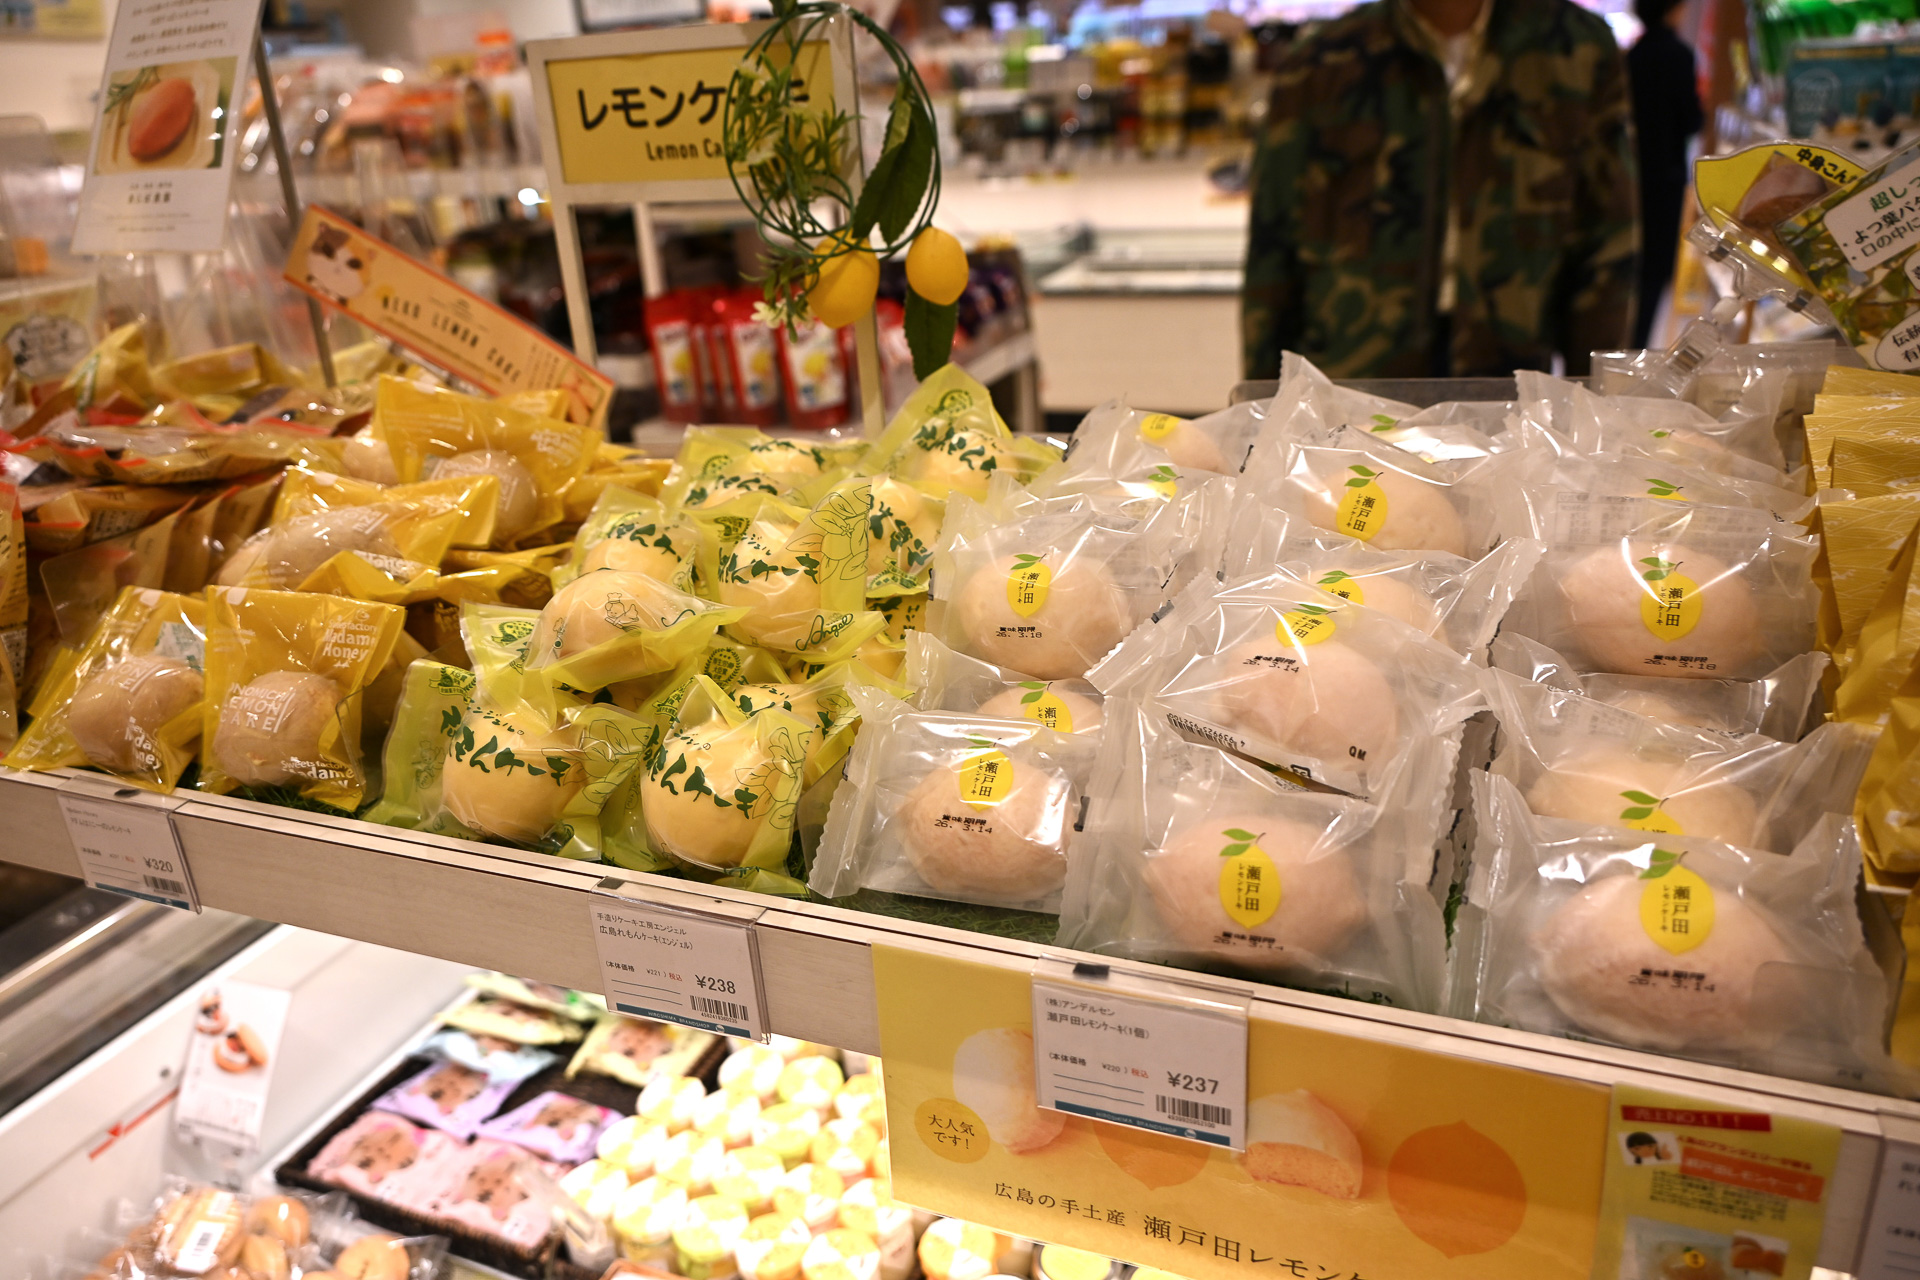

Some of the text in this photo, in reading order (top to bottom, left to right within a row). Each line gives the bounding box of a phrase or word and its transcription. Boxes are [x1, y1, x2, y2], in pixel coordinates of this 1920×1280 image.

[578, 80, 810, 130] レモンケ
[646, 138, 725, 160] Lemon Ca
[1353, 495, 1376, 532] 瀬戸田
[1023, 572, 1040, 604] 瀬戸田
[1665, 587, 1684, 627] 瀬戸田
[796, 612, 854, 651] Angel
[322, 642, 370, 662] Honey
[224, 696, 284, 716] EMON
[1044, 706, 1057, 729] 瀬戸
[1348, 745, 1367, 761] QM
[979, 760, 999, 798] 瀬戸田
[143, 856, 174, 873] ¥320
[1245, 865, 1262, 912] 瀬戸田
[1672, 885, 1691, 935] 瀬戸田
[597, 912, 687, 936] 手造りケーキ工房エンジェル
[695, 974, 737, 995] ¥238
[1045, 997, 1116, 1017] (株)アンデルセン
[1167, 1071, 1219, 1095] ¥237
[928, 1114, 975, 1137] 大人気
[995, 1182, 1126, 1227] 広島の手土産
